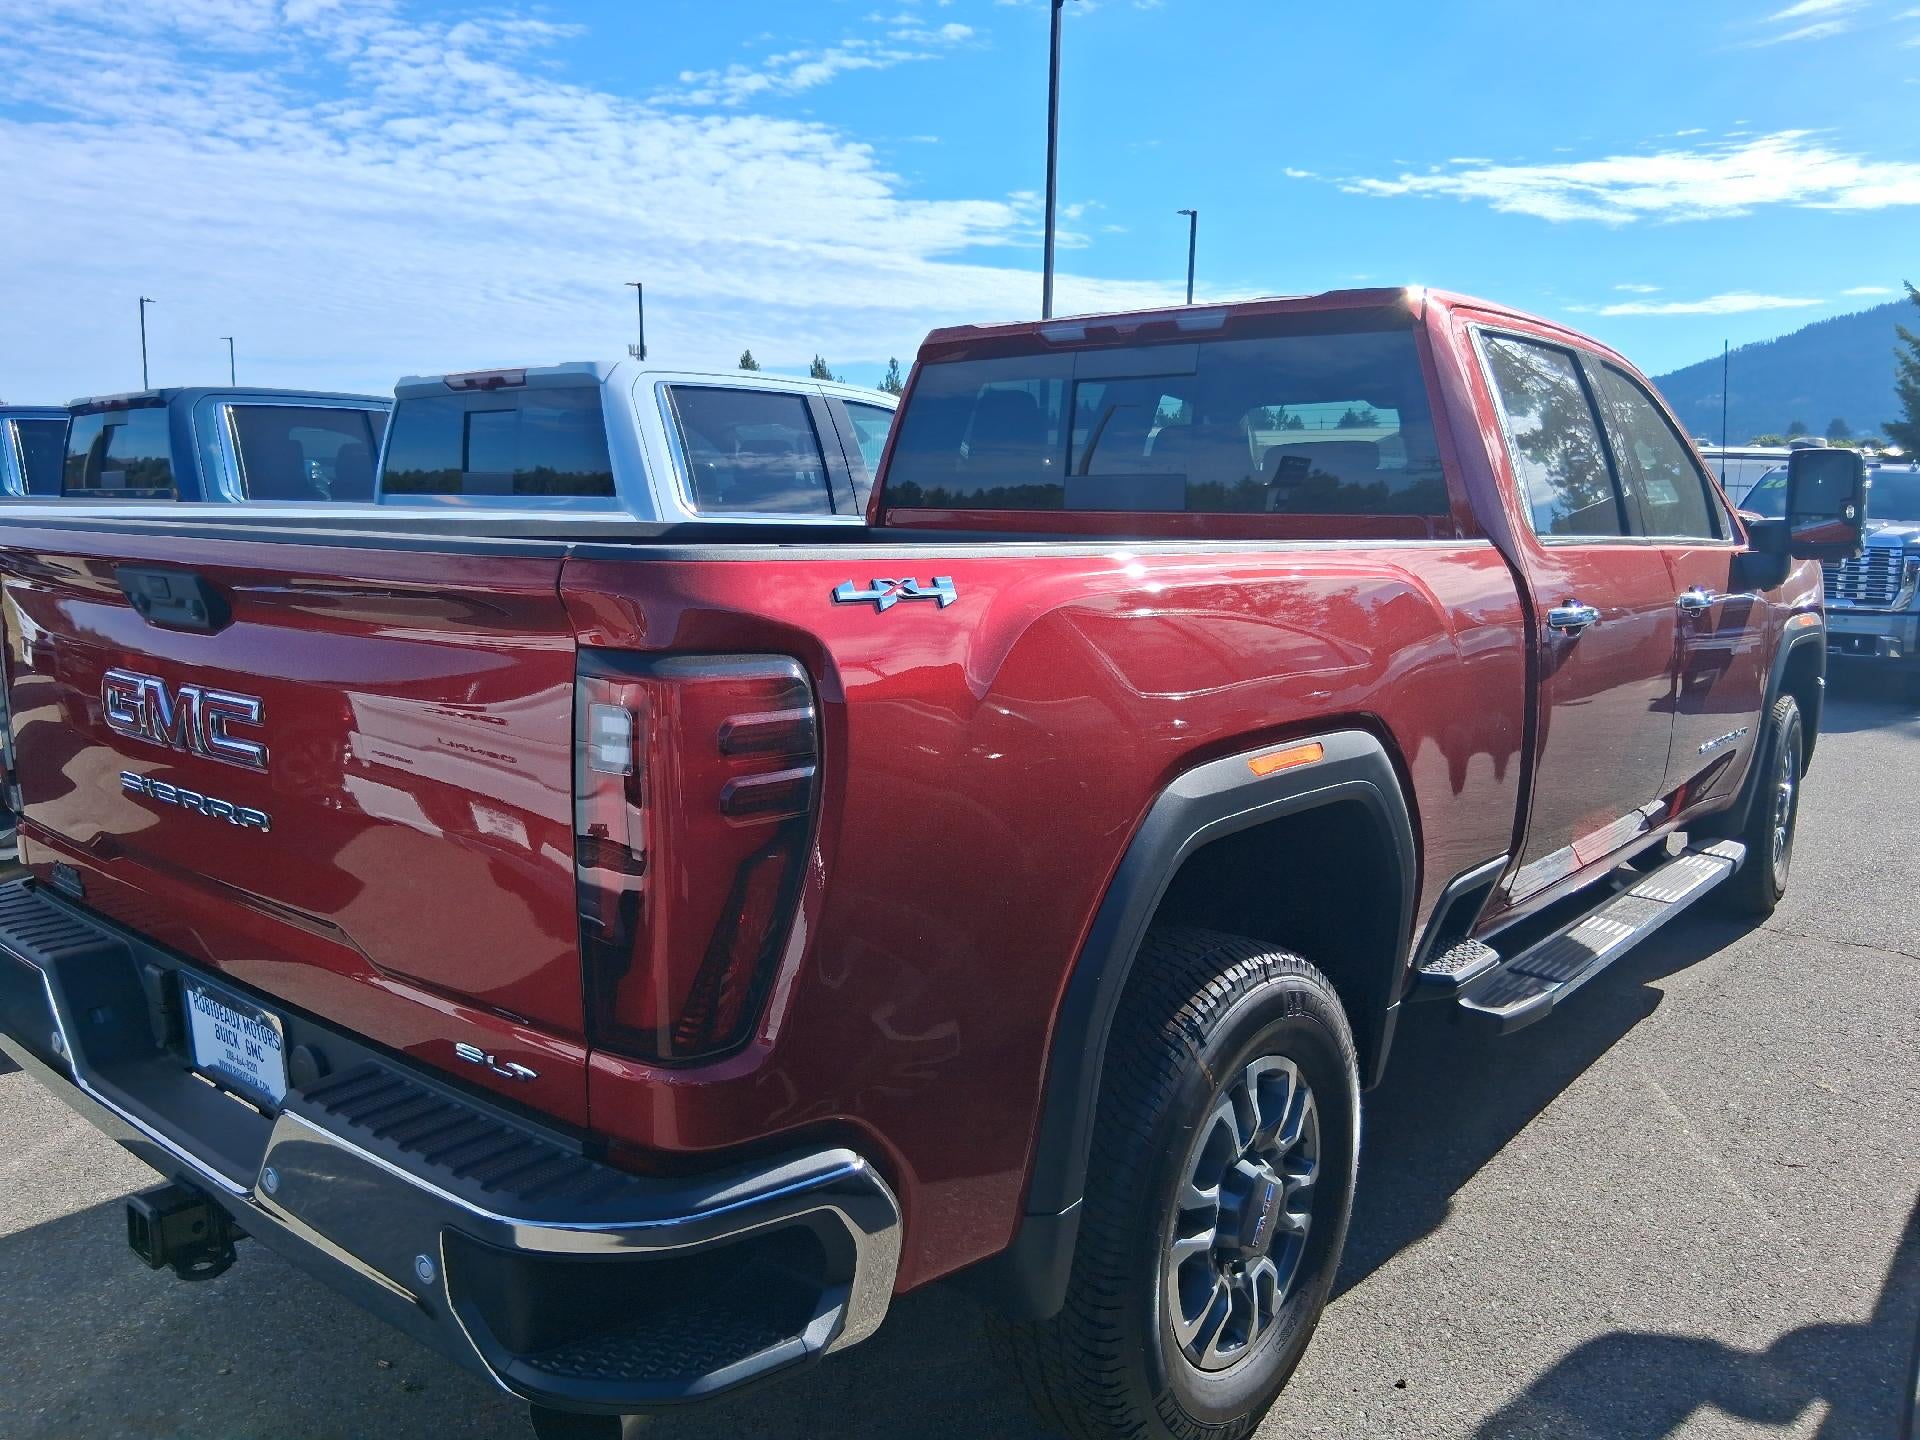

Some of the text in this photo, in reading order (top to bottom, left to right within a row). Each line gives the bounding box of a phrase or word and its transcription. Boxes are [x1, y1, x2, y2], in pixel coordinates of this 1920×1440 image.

[102, 668, 269, 774] GMC
[119, 770, 273, 833] SIERRA
[215, 1024, 265, 1063] BUICK GMC
[243, 1015, 281, 1051] MOTORS
[455, 1042, 540, 1080] SLT
